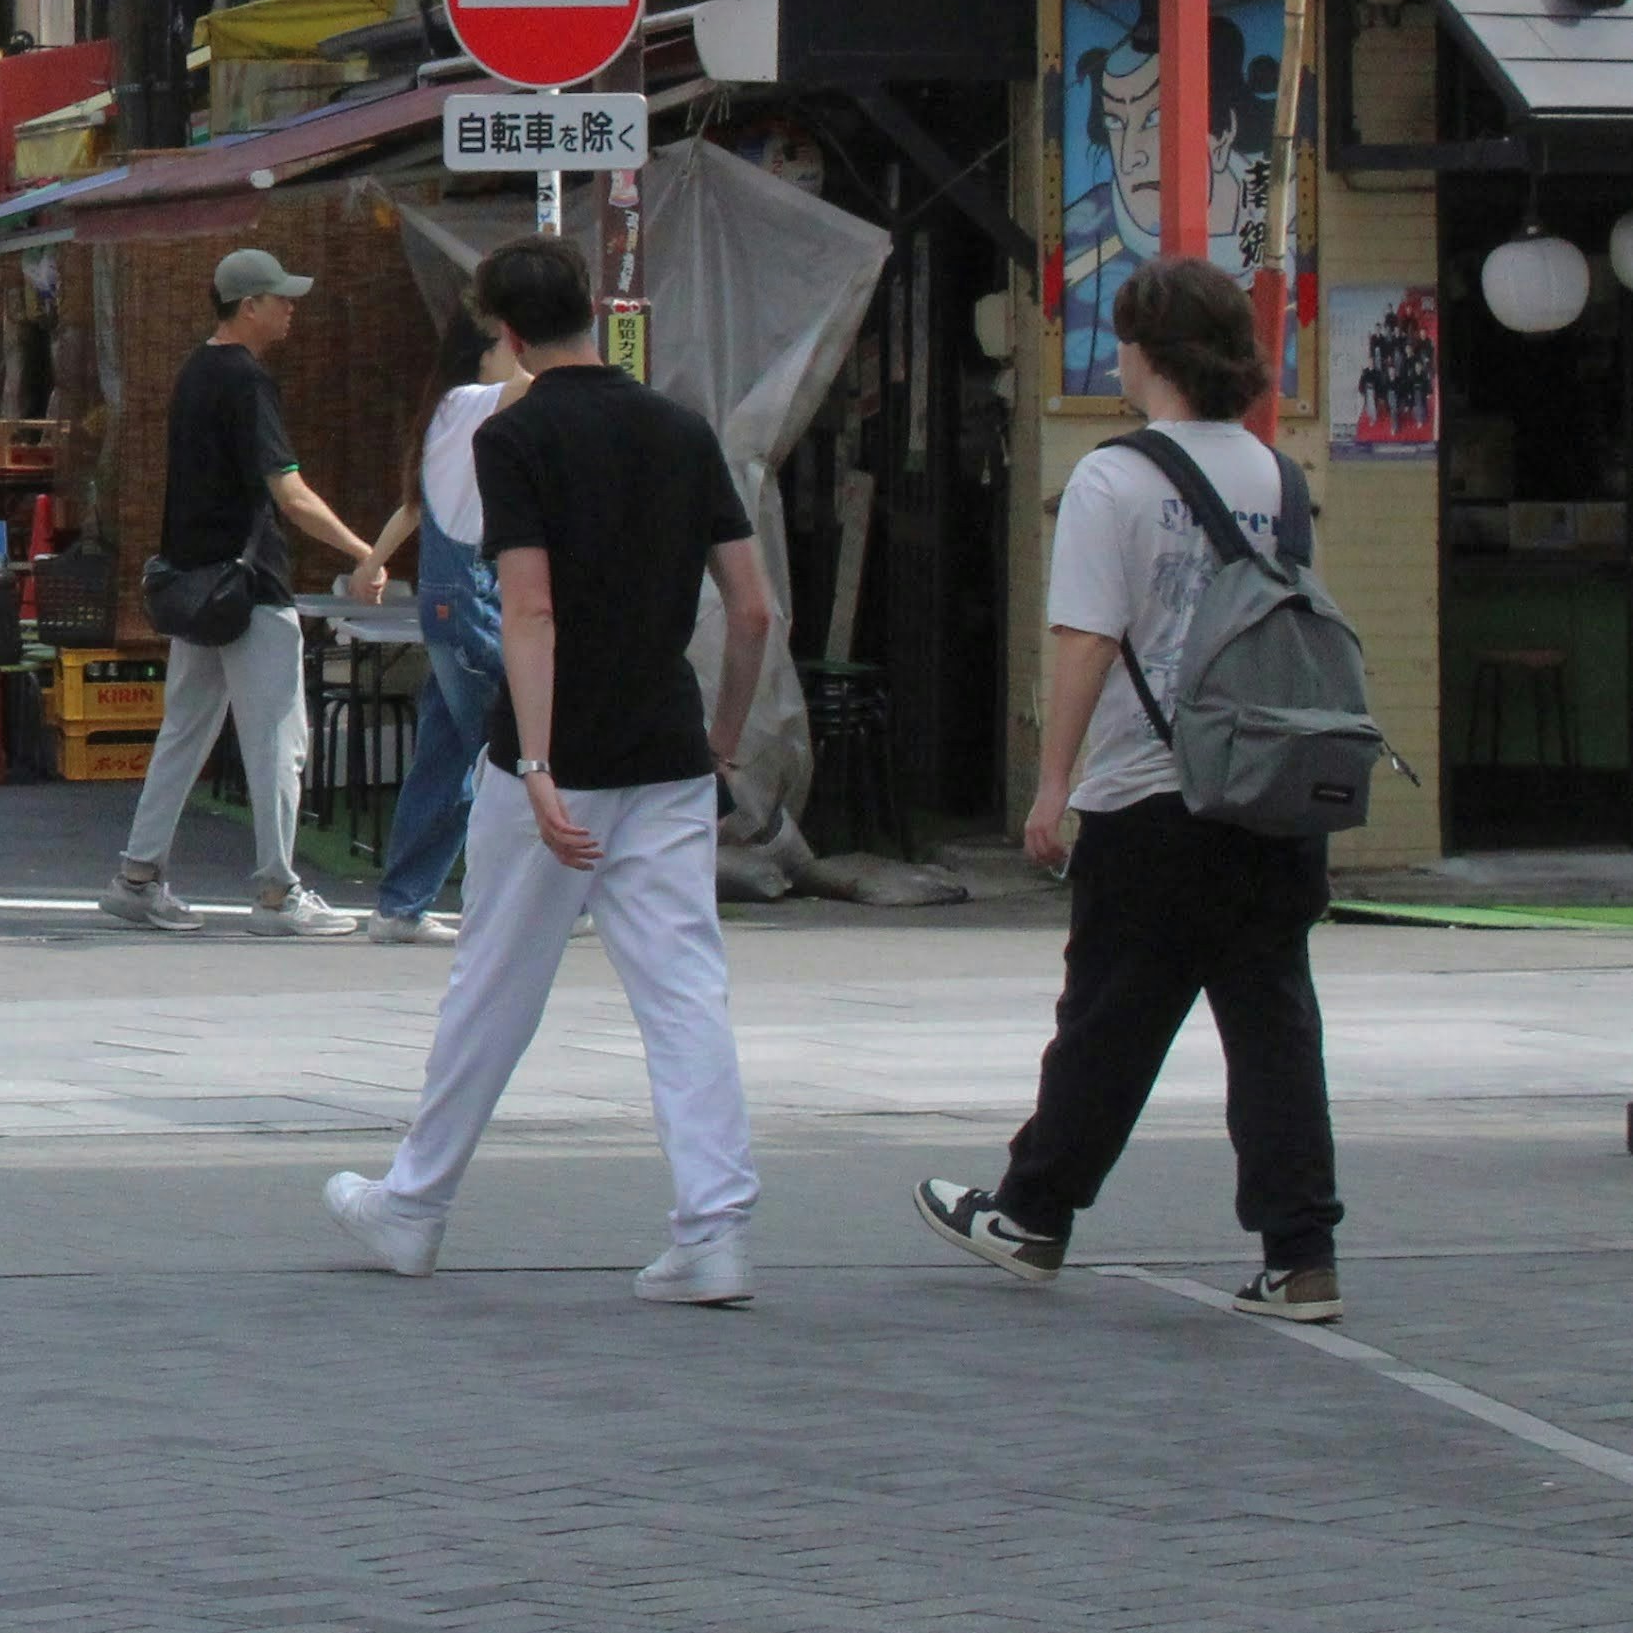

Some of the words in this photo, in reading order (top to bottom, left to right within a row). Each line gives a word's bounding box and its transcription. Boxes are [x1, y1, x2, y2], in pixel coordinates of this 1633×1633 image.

[457, 113, 635, 154] 自転車を除く
[97, 687, 154, 704] KIRIN
[93, 750, 151, 771] ホッピ
